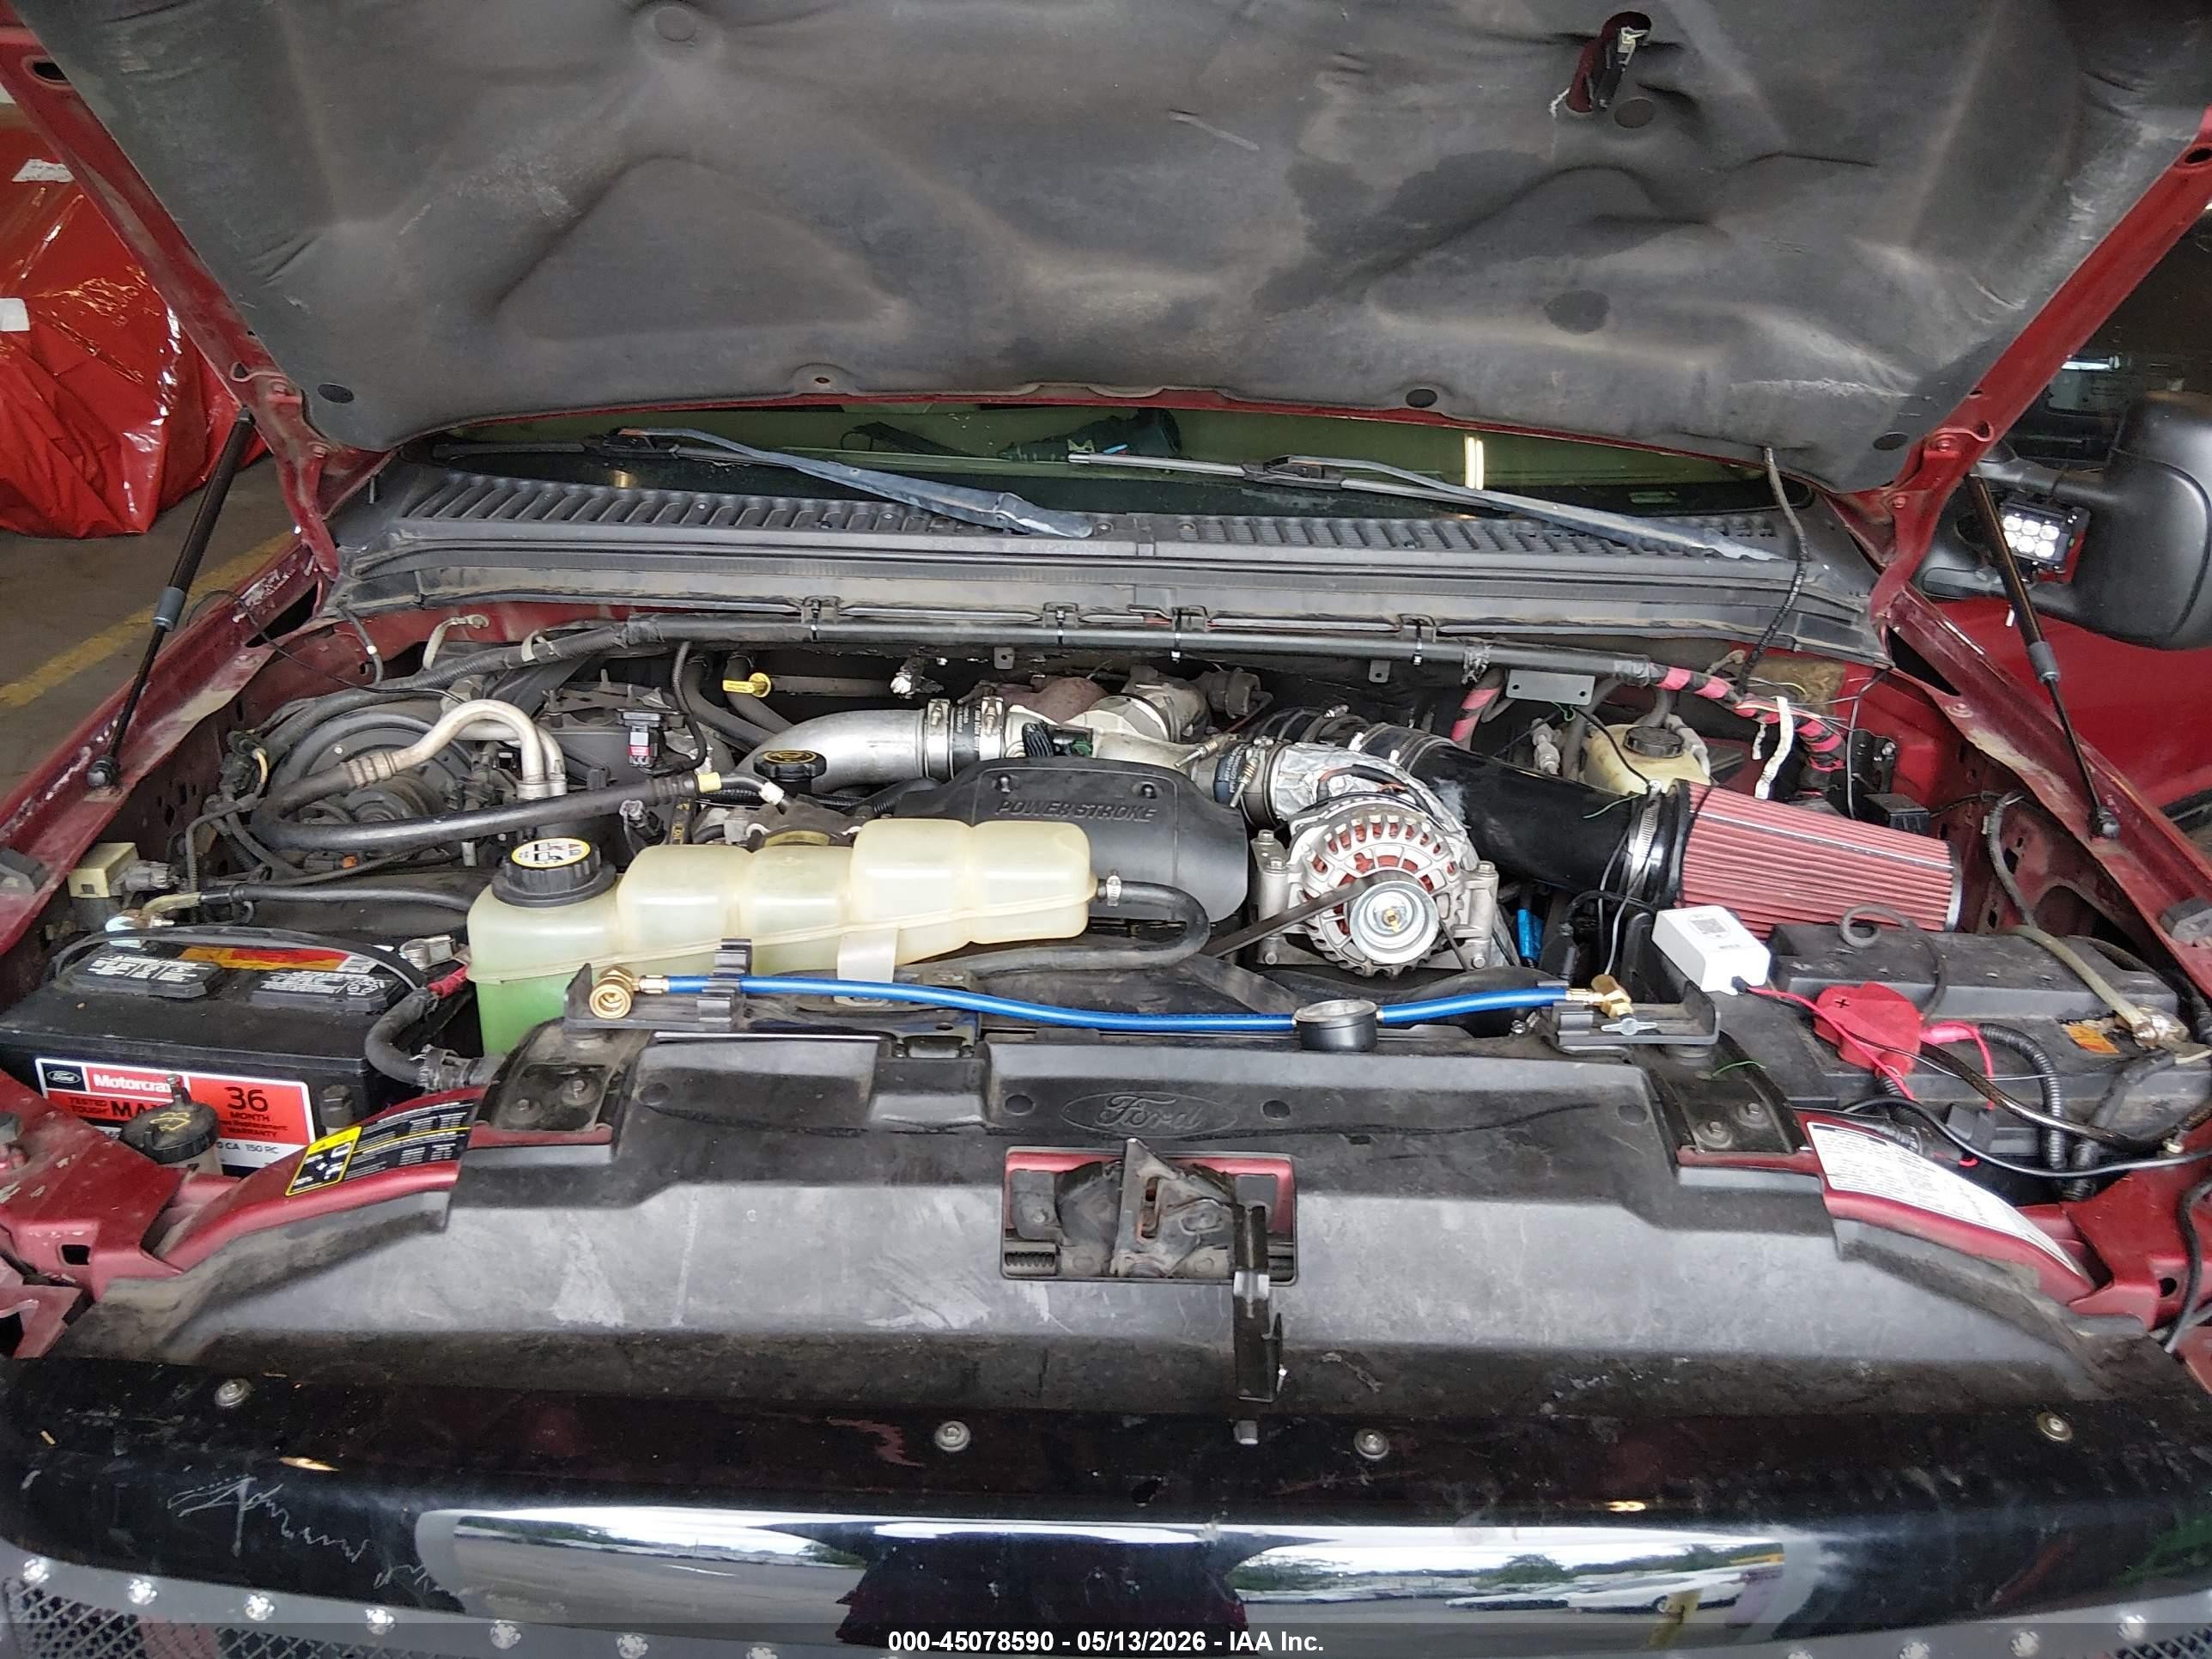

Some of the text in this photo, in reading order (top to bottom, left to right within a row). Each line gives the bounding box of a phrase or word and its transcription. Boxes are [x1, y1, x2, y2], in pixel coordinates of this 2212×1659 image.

[995, 800, 1158, 823] POWER STROKE
[93, 1073, 172, 1094] Motorcra
[111, 1100, 160, 1118] MA
[224, 1086, 269, 1112] 36
[229, 1111, 270, 1122] MONTH
[1094, 1095, 1204, 1130] Ford
